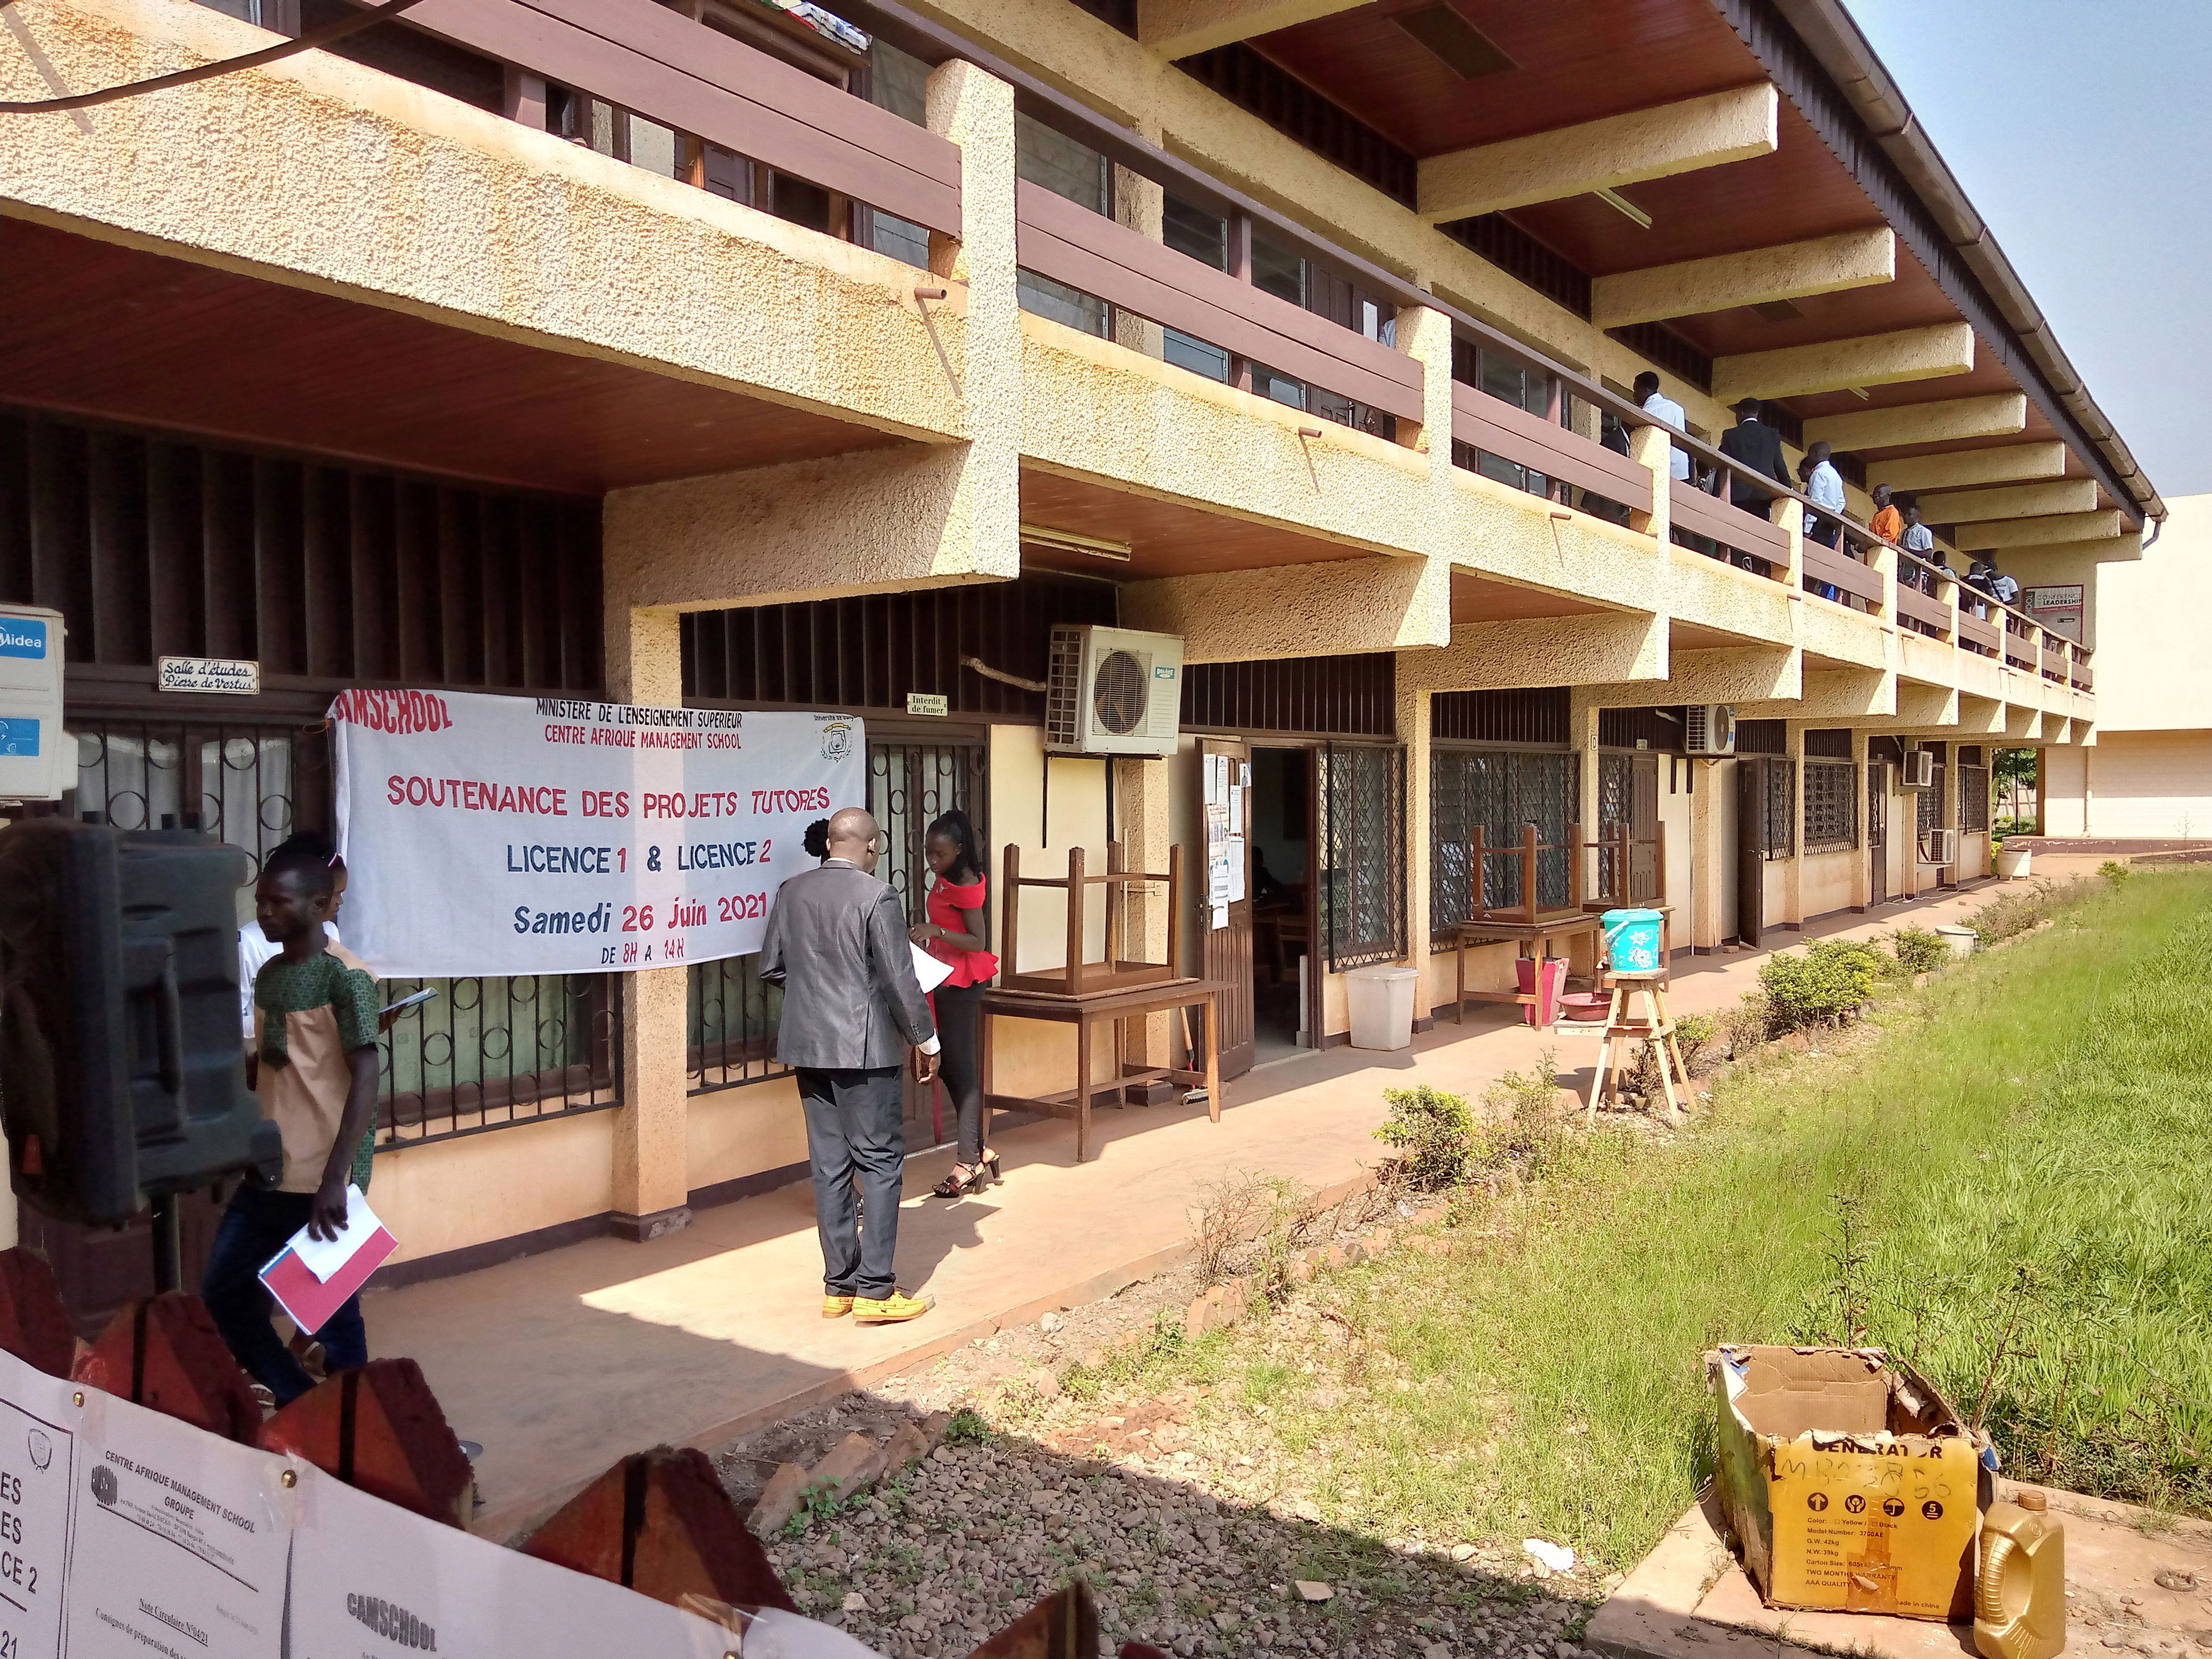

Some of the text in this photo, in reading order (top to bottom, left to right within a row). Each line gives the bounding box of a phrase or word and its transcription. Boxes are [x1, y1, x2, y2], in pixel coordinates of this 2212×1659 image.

[0, 632, 41, 648] Midea
[164, 674, 198, 687] Pierre
[201, 677, 214, 688] de
[165, 661, 194, 674] Salle
[536, 698, 742, 729] MINISTERE DE L'ENSEIGNEMENT SUPERIEUR
[912, 696, 941, 705] Interdit
[923, 705, 944, 714] fumer
[544, 724, 742, 750] CENTRE AFRIQUE MANAGEMENT SCHOOL
[387, 775, 831, 819] SOUTENANCE DES PROJETS TUTORES
[507, 839, 772, 873] LICENCE 1 & LICENCE 2
[513, 901, 611, 935] Samedi
[621, 905, 654, 933] 26
[717, 892, 768, 923] 2021
[601, 938, 685, 965] DE 8H A 14H
[1812, 1437, 1942, 1459] ENRATR
[105, 1450, 134, 1471] CENTRE
[135, 1464, 170, 1487] AFRIQUE
[170, 1479, 222, 1515] MANAGEMENT
[222, 1509, 256, 1534] SCHOOL
[164, 1496, 195, 1520] GROUPE
[28, 1566, 37, 1595] 2
[1855, 1571, 1896, 1580] WARRANTY
[138, 1597, 153, 1614] Note
[155, 1606, 185, 1630] Circulaire
[347, 1592, 437, 1652] CAMSCHOOL
[96, 1607, 125, 1630] Consignes
[126, 1623, 132, 1635] de
[133, 1629, 168, 1655] préparation
